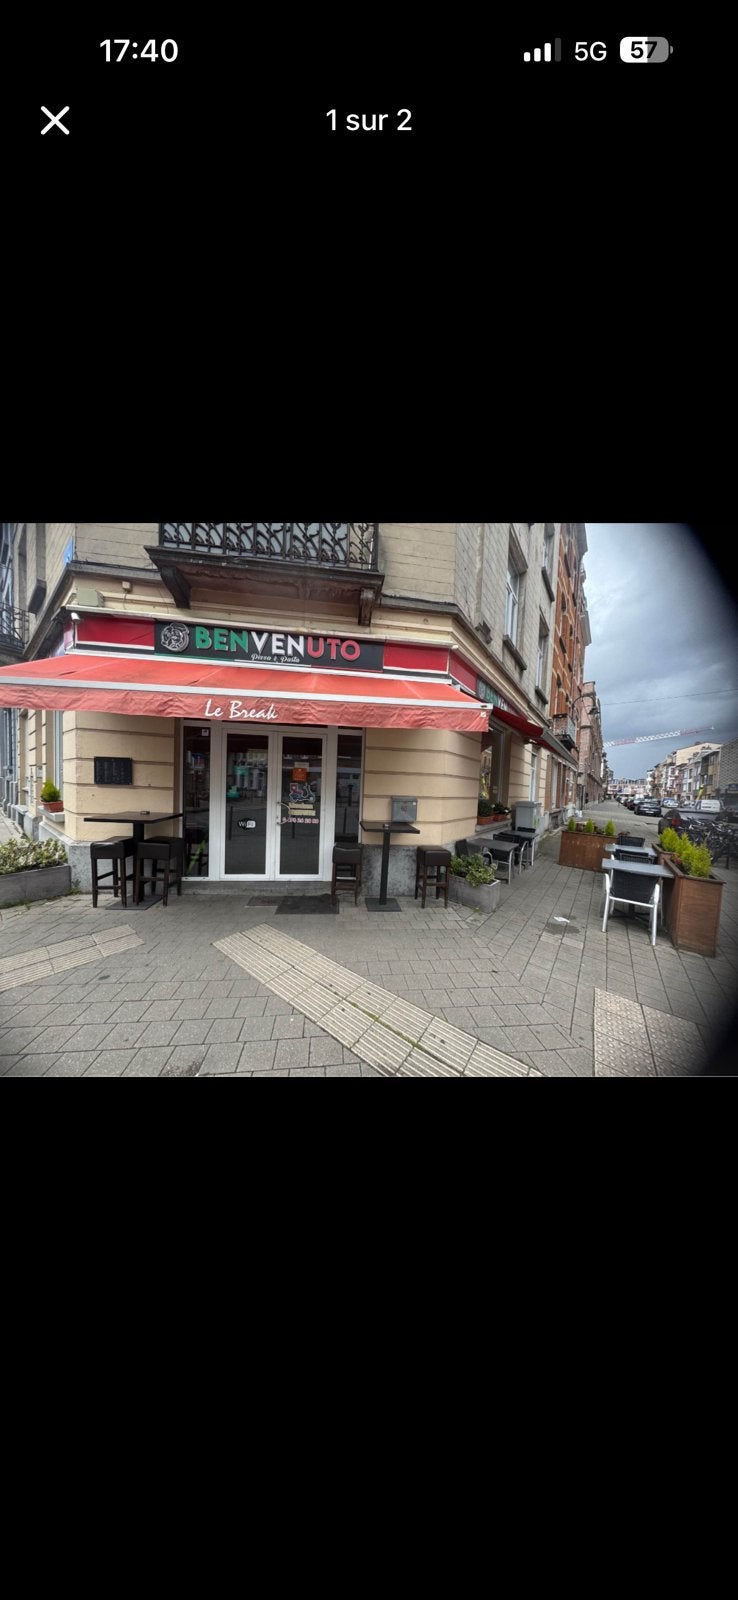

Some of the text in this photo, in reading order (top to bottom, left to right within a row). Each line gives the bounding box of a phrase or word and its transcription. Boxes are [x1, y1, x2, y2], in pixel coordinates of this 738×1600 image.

[195, 627, 361, 661] BENVENUTO
[205, 699, 279, 720] Le Break
